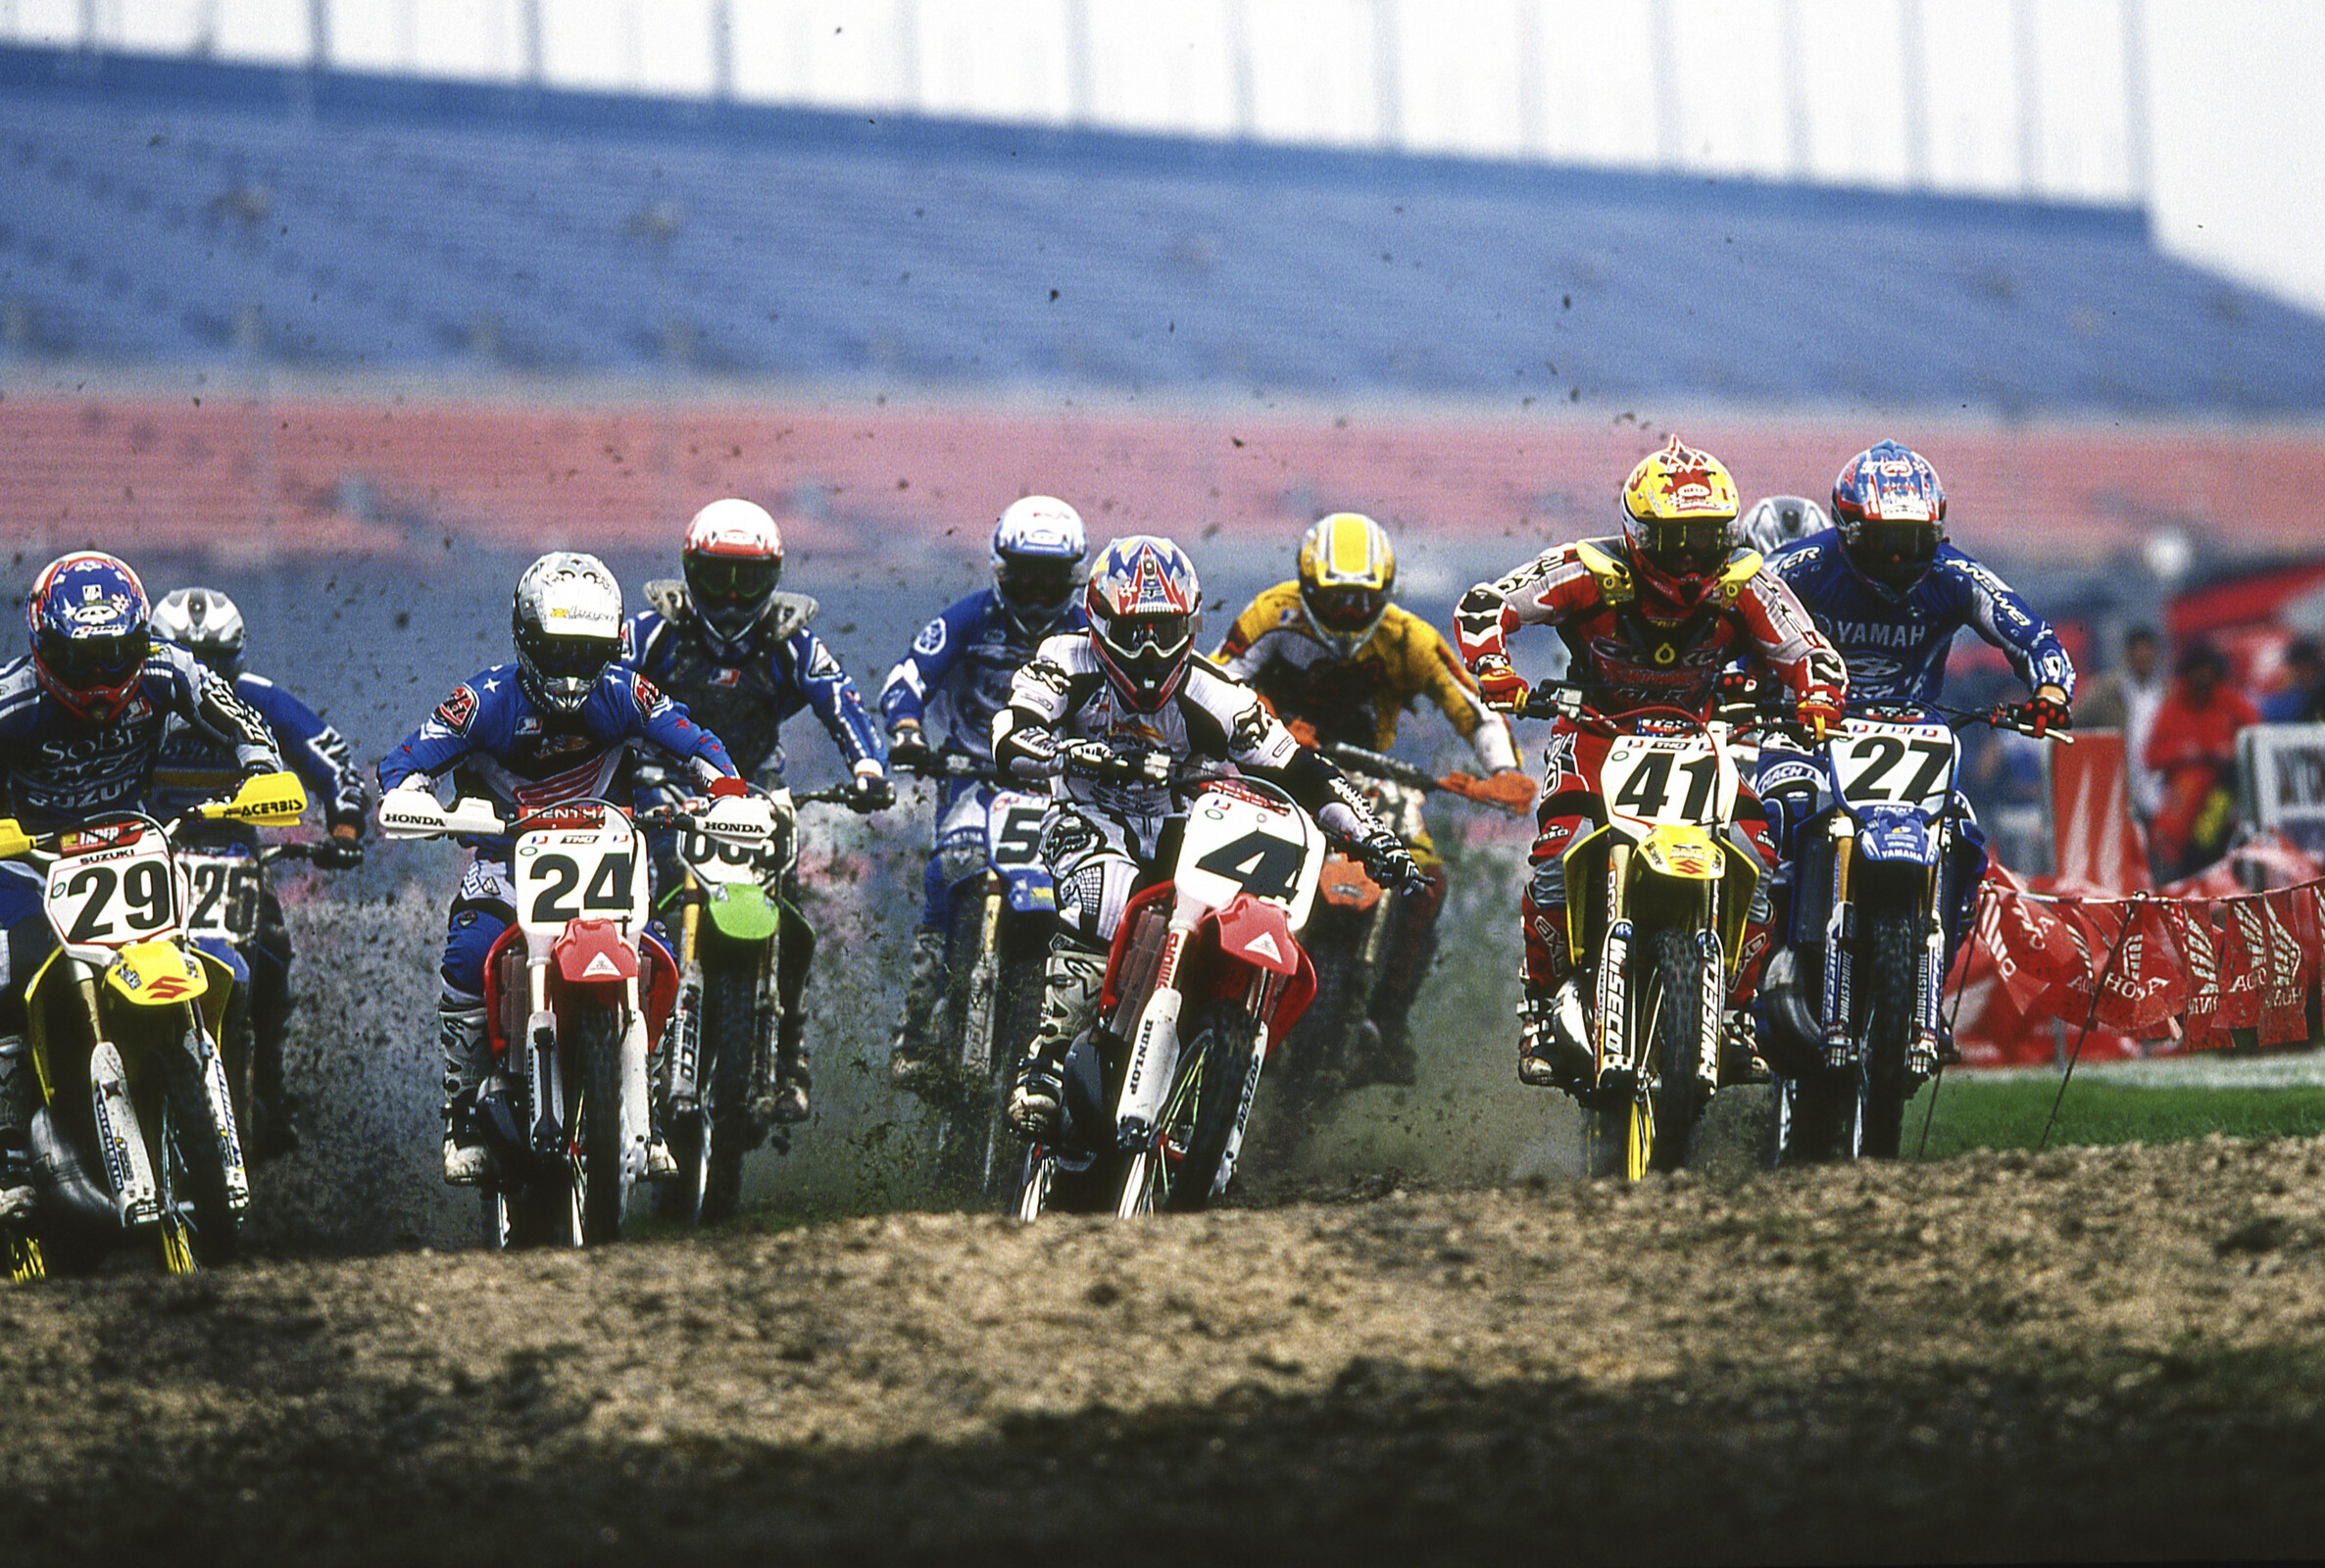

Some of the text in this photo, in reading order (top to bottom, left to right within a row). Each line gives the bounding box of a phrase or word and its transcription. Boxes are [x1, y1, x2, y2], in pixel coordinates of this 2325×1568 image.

[1837, 620, 1926, 648] YAMAH
[1615, 753, 1718, 825] 41
[1844, 736, 1953, 806] 27
[241, 799, 304, 817] ACERBIS
[385, 812, 446, 827] HONDA
[705, 821, 766, 833] HONDA
[79, 849, 135, 865] SUZUKI
[529, 853, 634, 923] 24
[1195, 829, 1310, 905] 4
[1881, 849, 1924, 862] YAMAHA
[68, 860, 170, 944] 29
[1605, 937, 1627, 1055] WISECO
[1839, 951, 1854, 1023] BRIDGESTONE
[1914, 953, 1929, 1028] BRIDGESTONE
[1129, 1019, 1154, 1095] DUNLOP
[97, 1103, 124, 1191] MICHELIN
